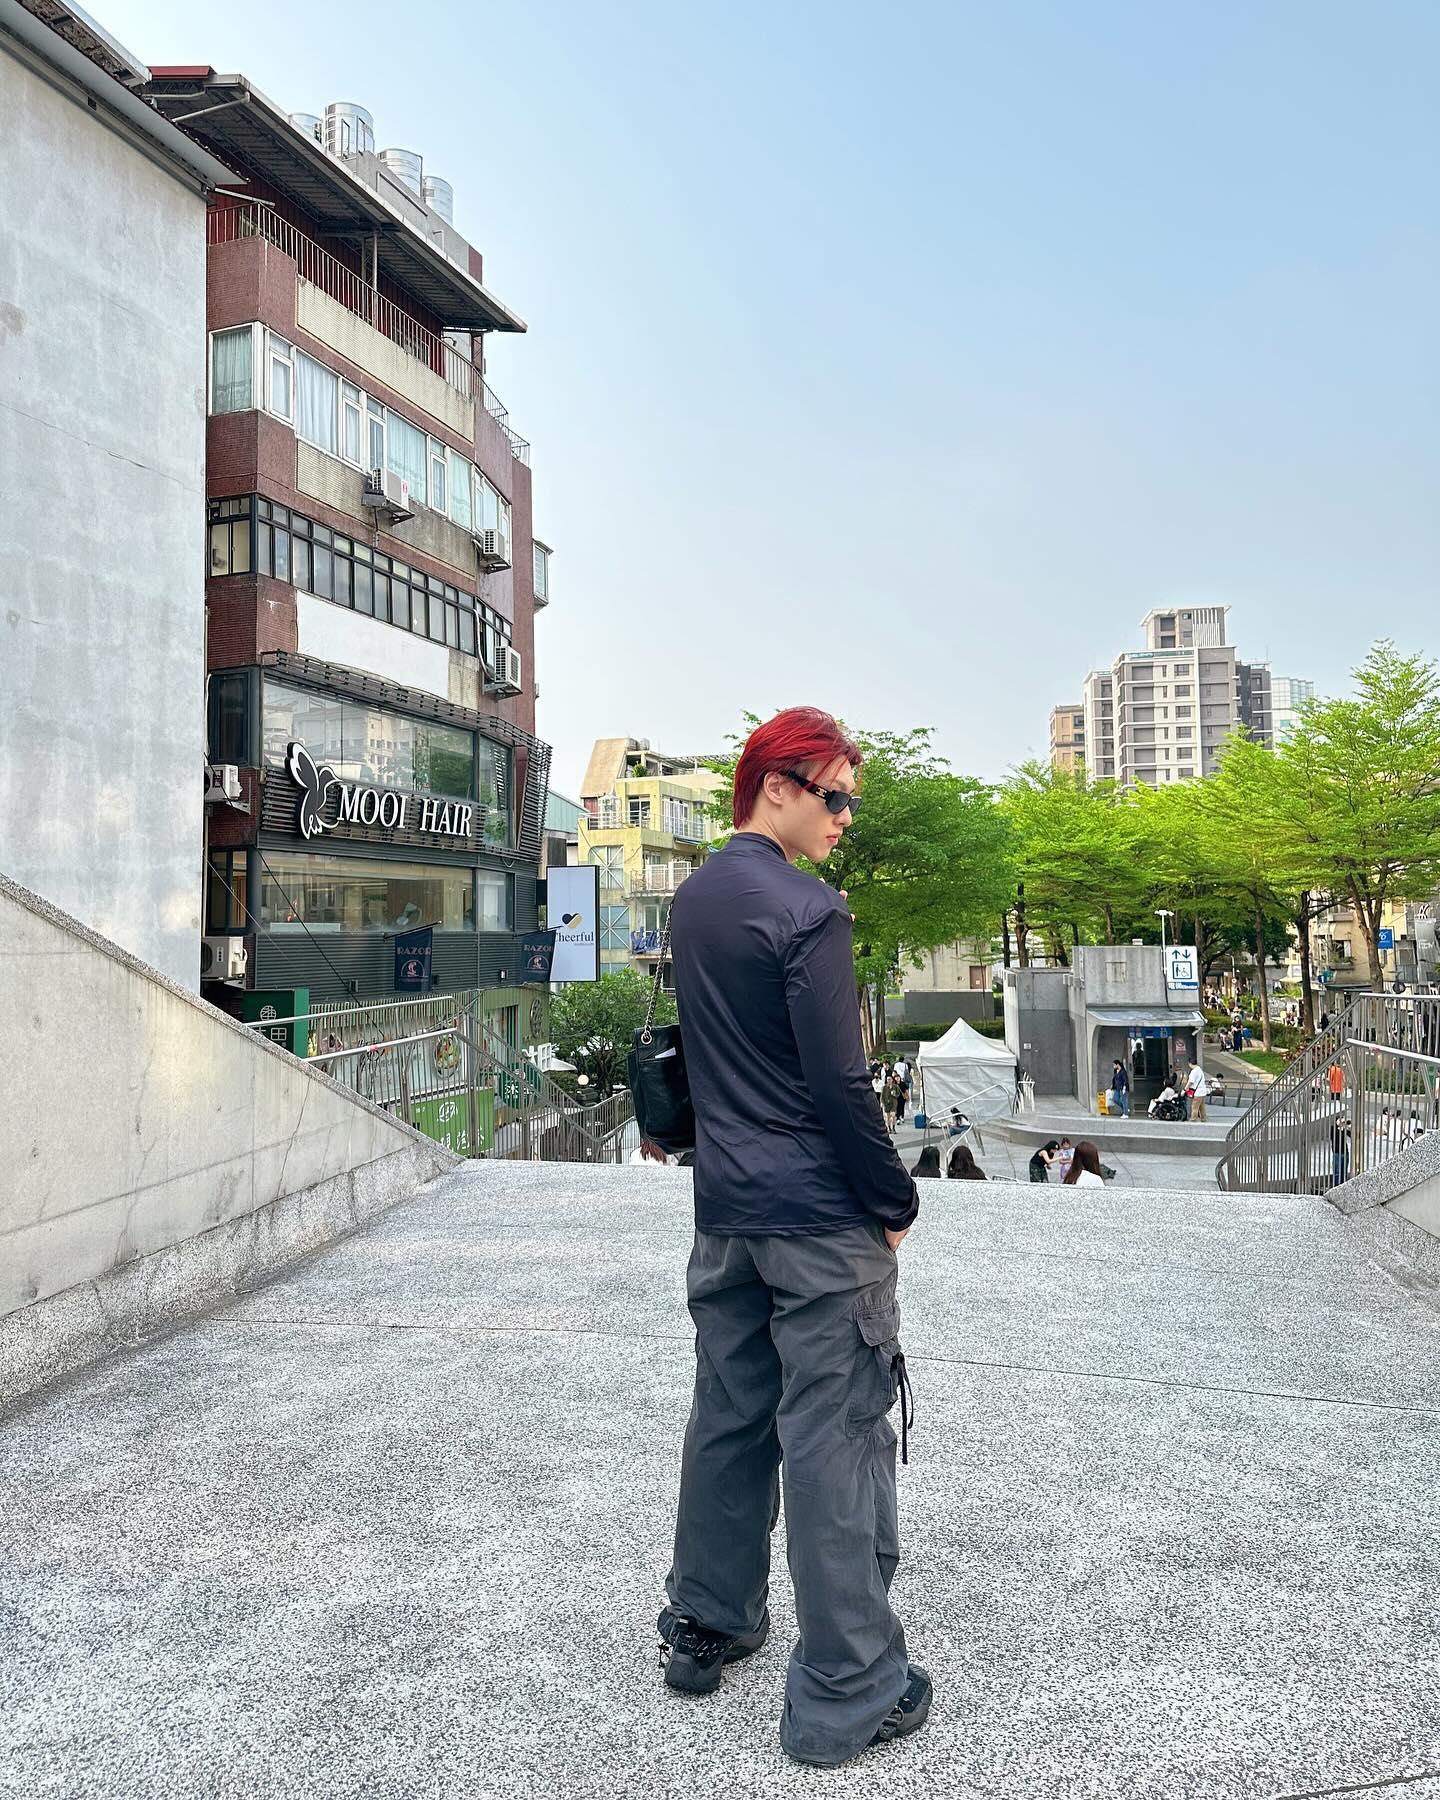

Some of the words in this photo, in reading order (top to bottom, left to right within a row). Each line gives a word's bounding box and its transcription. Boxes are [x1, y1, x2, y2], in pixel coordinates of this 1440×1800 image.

[337, 784, 409, 829] MOOI
[419, 798, 472, 837] HAIR
[396, 946, 432, 956] RAZOR
